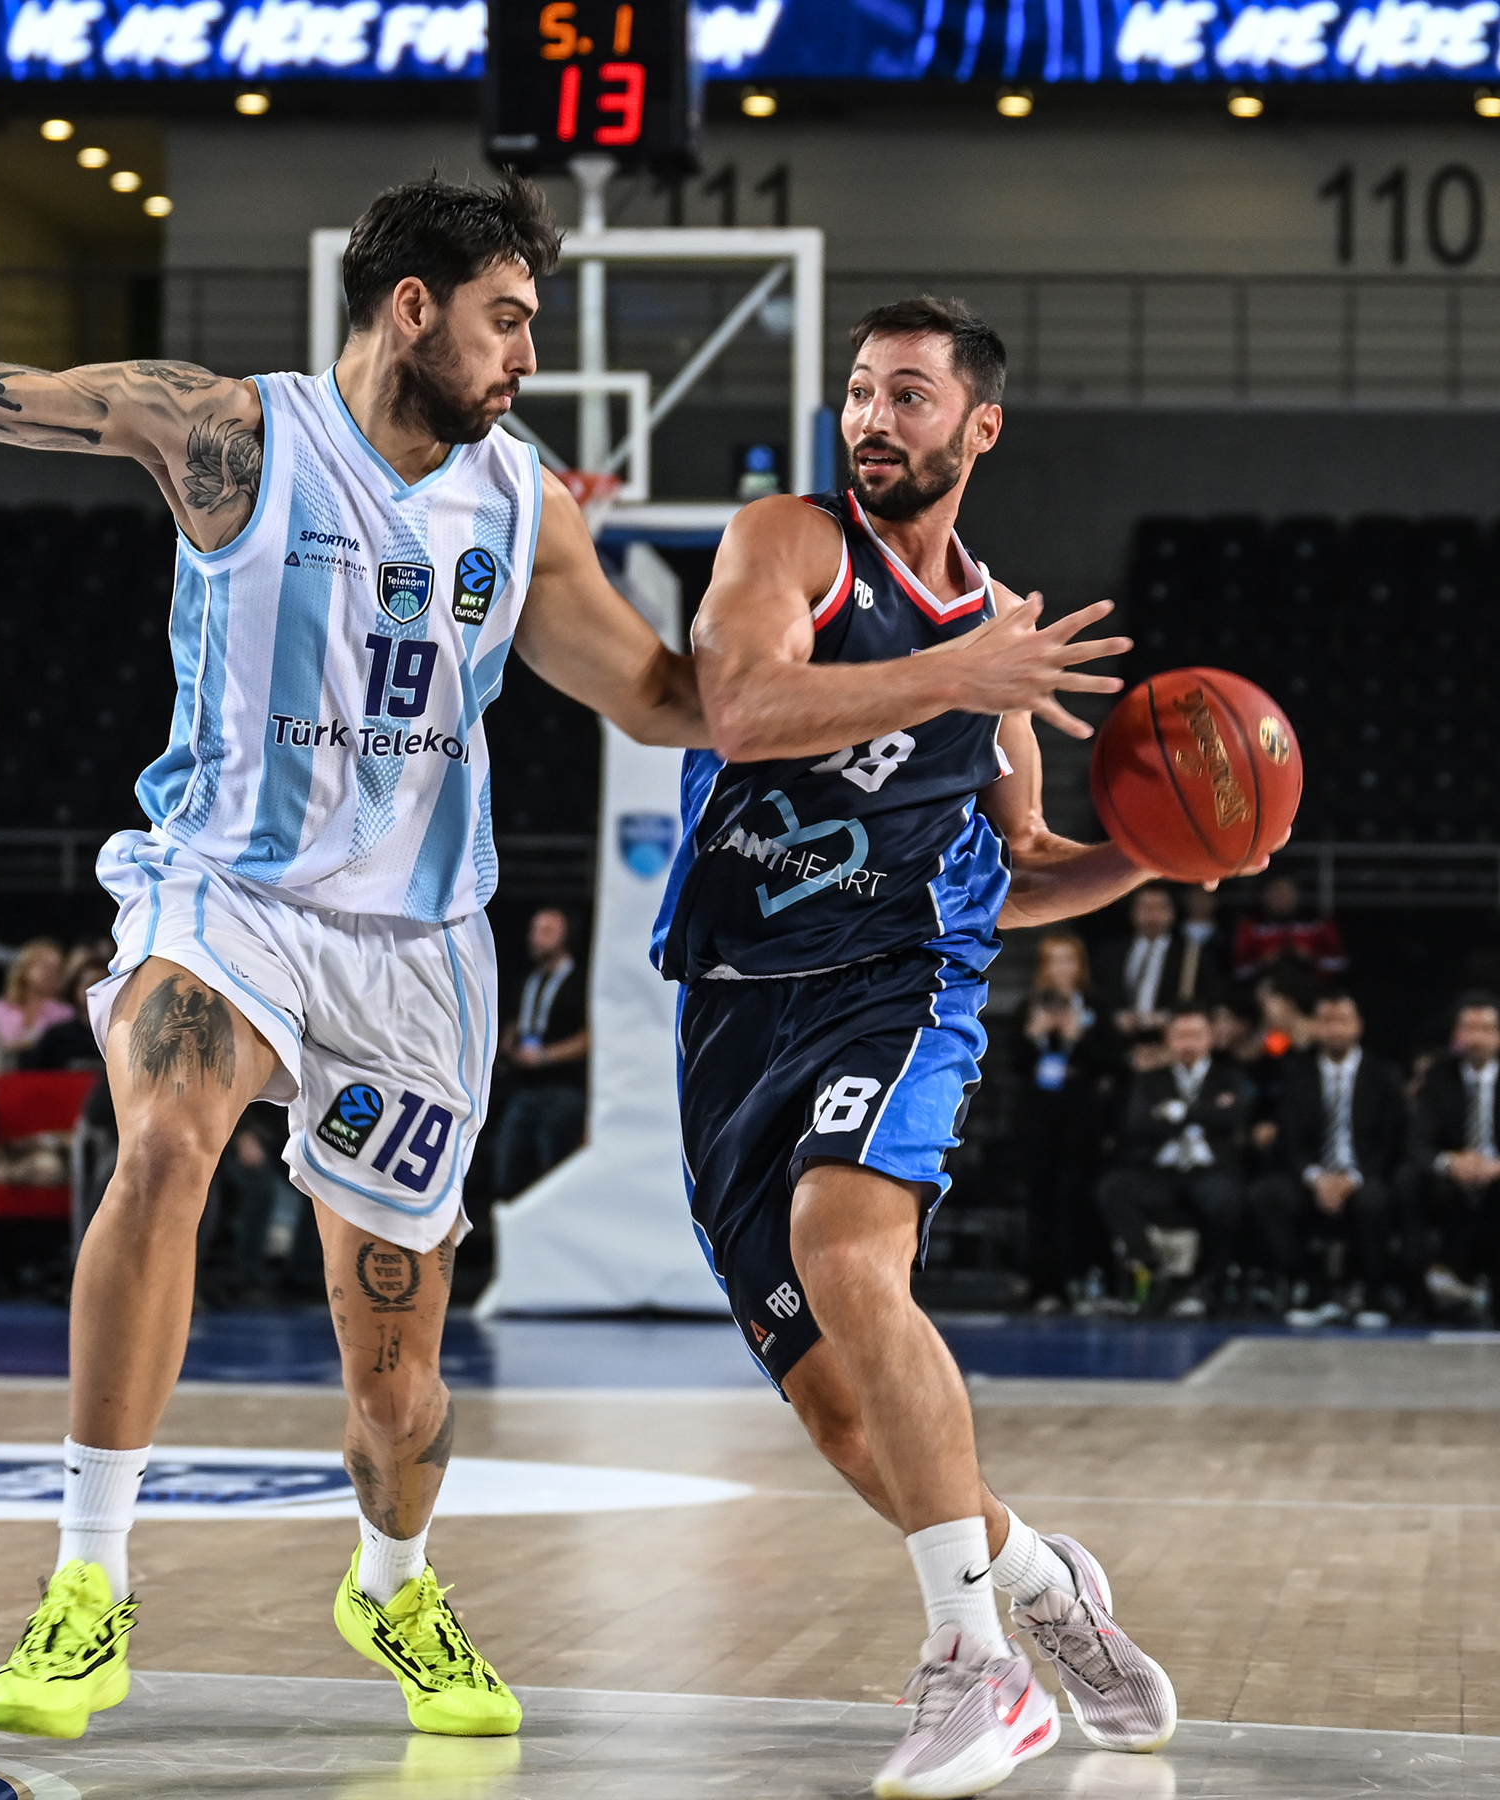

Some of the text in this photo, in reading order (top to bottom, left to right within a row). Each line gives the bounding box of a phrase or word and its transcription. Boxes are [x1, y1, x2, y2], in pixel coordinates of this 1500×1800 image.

[6, 0, 488, 75] WE ARE HERE FOR
[1117, 0, 1500, 76] WE ARE HERE
[556, 62, 646, 146] 13
[1316, 161, 1485, 266] 110
[299, 530, 361, 553] SPORTIVE
[303, 552, 343, 566] ANKARA
[396, 567, 417, 579] Türk
[386, 575, 426, 589] Telekom
[454, 605, 485, 621] EuroCup
[460, 592, 486, 607] BKT
[364, 632, 440, 718] 19
[271, 713, 350, 748] Türk
[320, 1124, 357, 1155] EuroCup
[329, 1117, 361, 1141] BKT
[370, 1089, 455, 1194] 19
